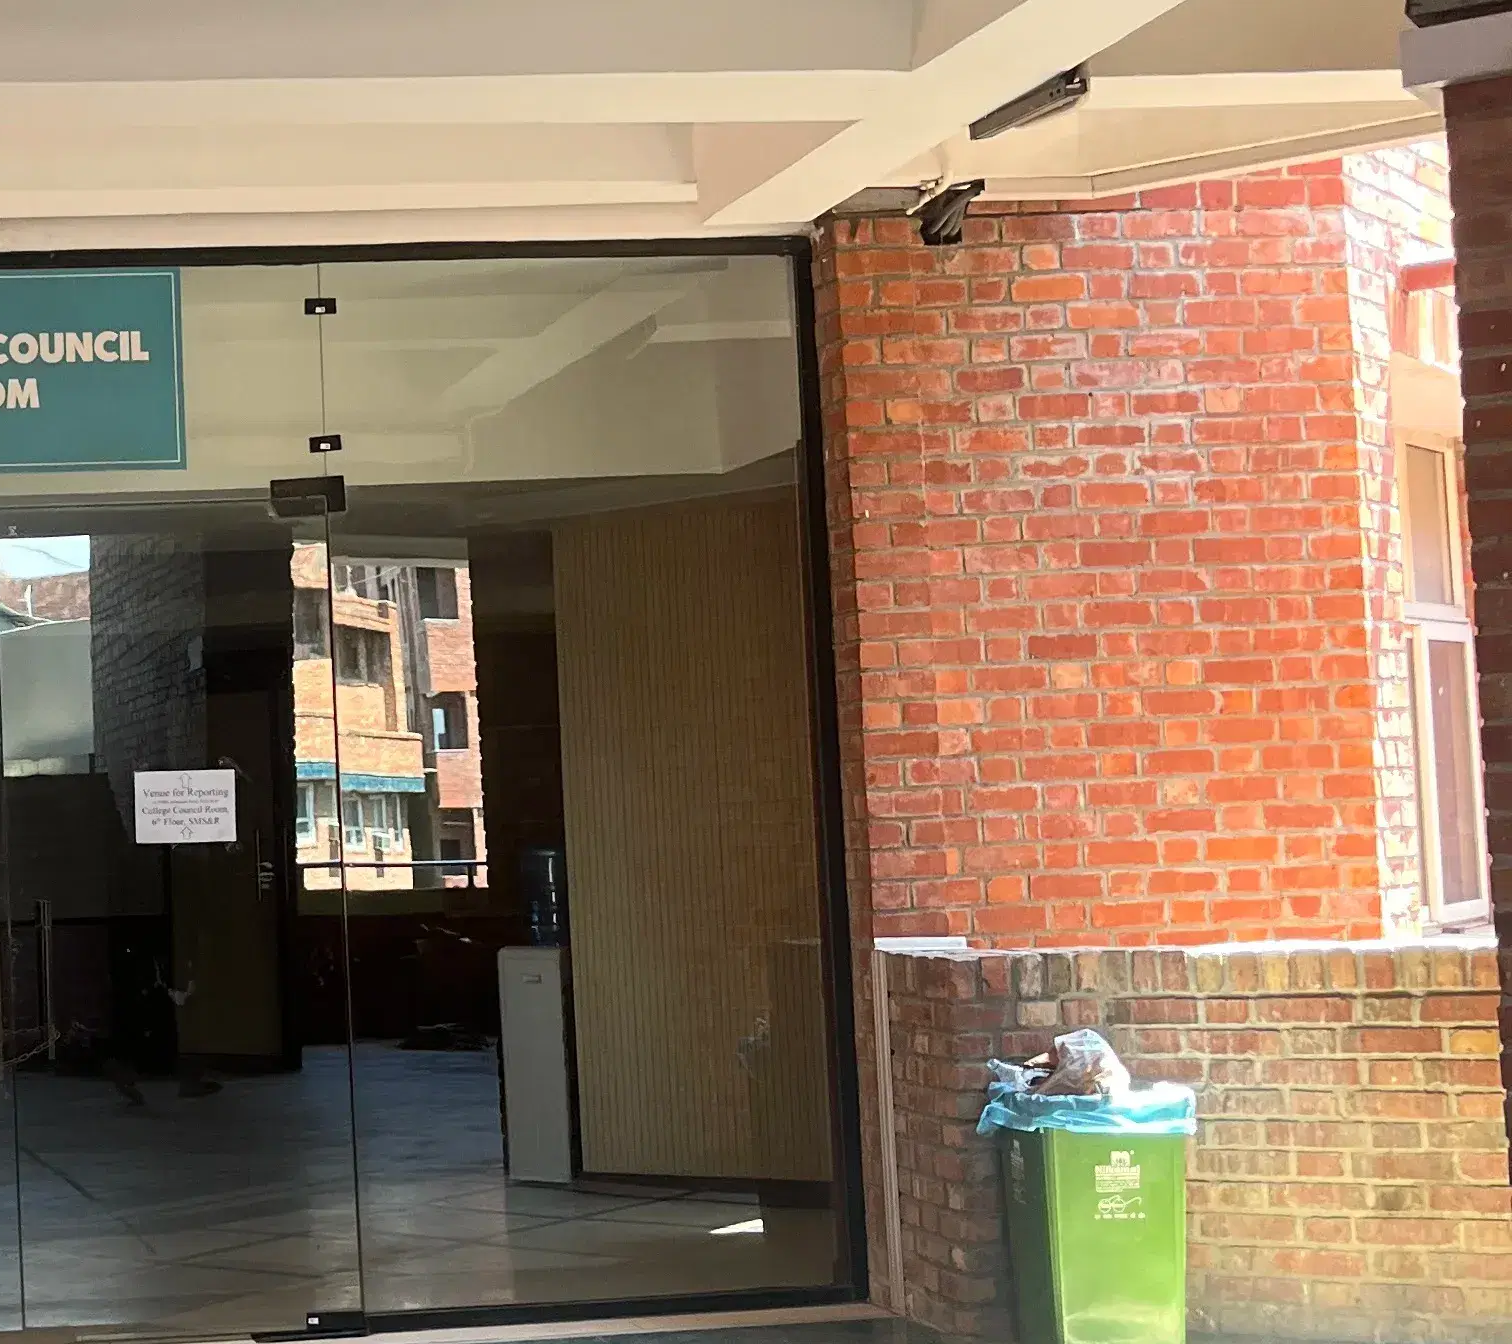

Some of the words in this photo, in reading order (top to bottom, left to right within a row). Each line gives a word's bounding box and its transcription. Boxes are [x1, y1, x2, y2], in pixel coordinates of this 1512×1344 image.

[143, 788, 170, 798] Venue
[172, 788, 185, 797] for
[187, 787, 229, 798] Reporting
[141, 807, 170, 816] College
[172, 805, 203, 815] Council
